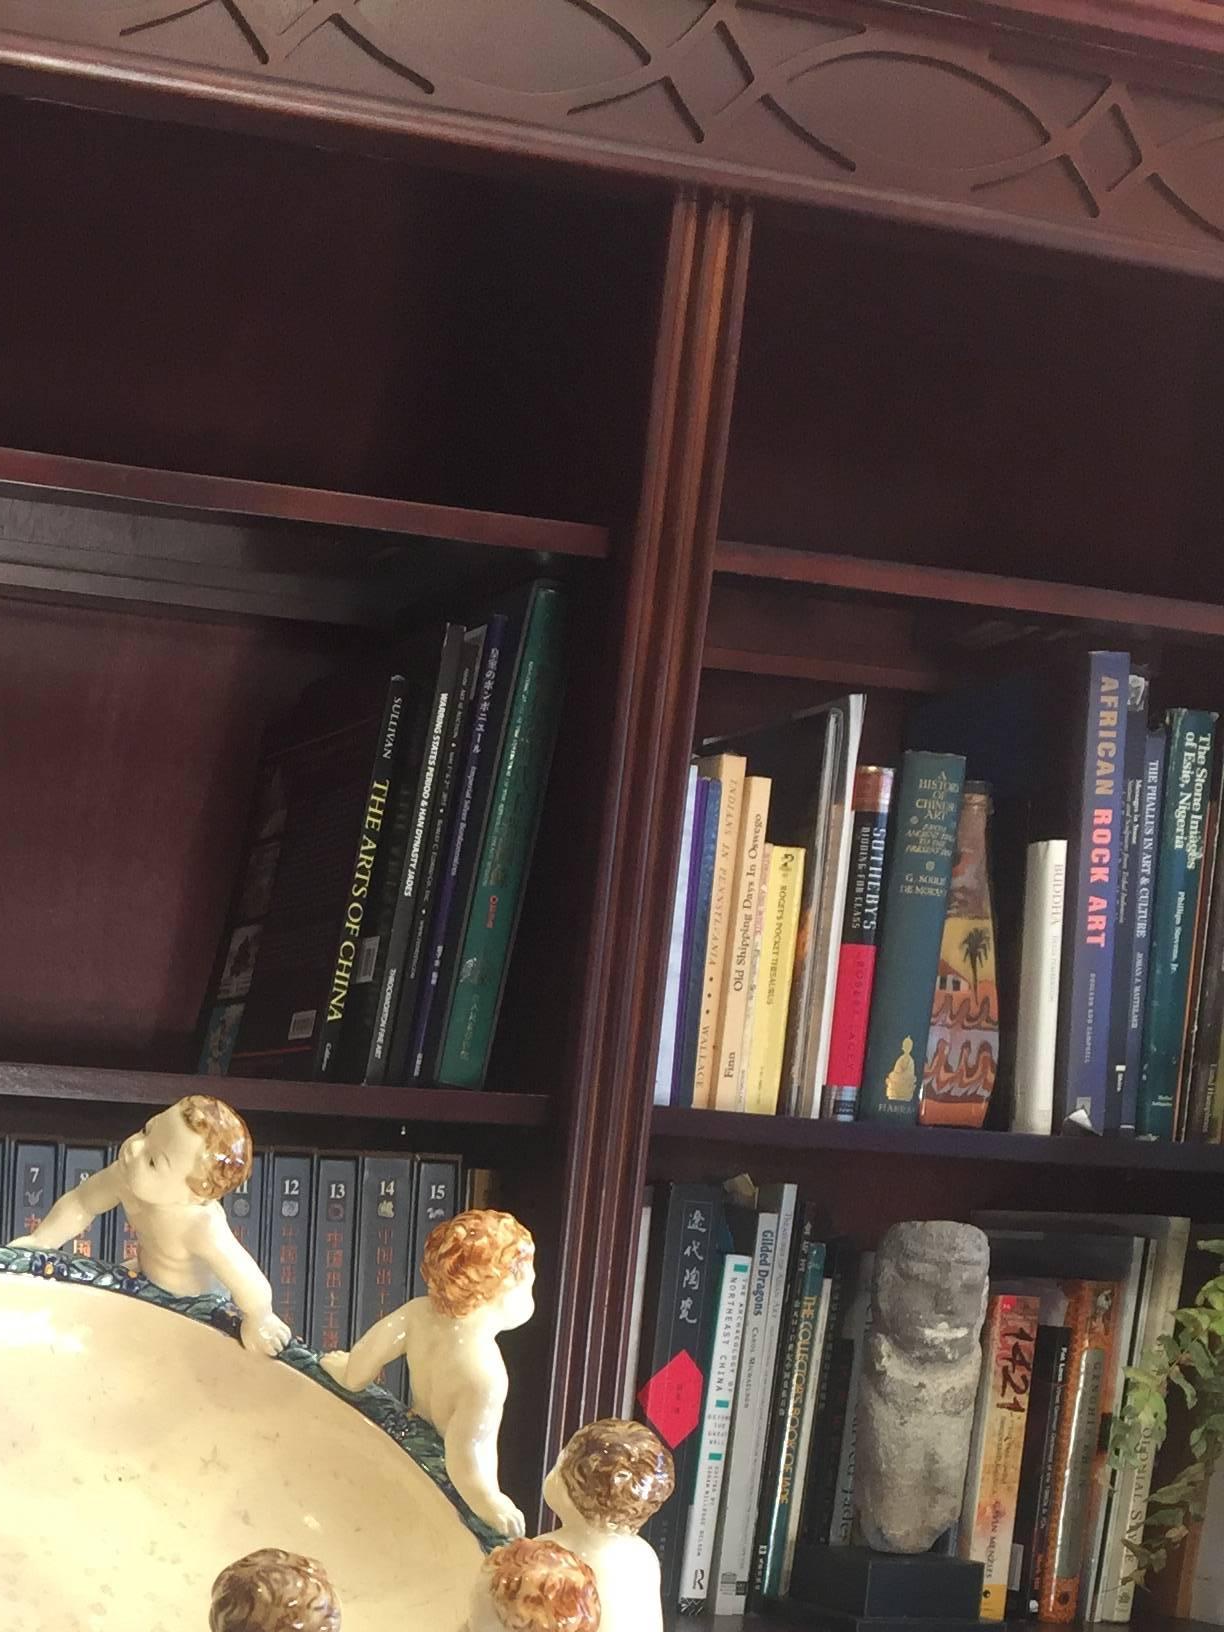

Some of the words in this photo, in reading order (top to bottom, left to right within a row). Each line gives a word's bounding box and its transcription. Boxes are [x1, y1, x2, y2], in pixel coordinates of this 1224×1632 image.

[382, 696, 403, 760] SULLIVAN
[433, 692, 449, 735] WARRING
[427, 735, 441, 766] STATES
[1095, 675, 1119, 795] AFRICAN
[1184, 731, 1197, 748] of
[1197, 732, 1212, 765] The
[422, 766, 435, 799] PERIOD
[937, 771, 947, 780] A
[1147, 760, 1160, 783] THE
[364, 778, 391, 832] THE
[421, 799, 429, 808] &
[1192, 767, 1208, 812] Stone
[416, 807, 427, 829] HAN
[924, 810, 946, 820] ART
[1144, 784, 1157, 836] PHALLUS
[1174, 791, 1192, 849] Nigeria
[409, 828, 423, 870] DYNASTY
[748, 812, 763, 860] Oswego
[856, 826, 870, 871] BIDDING
[1089, 808, 1113, 884] ROCK
[1143, 837, 1154, 850] IN
[1186, 814, 1204, 870] Images
[351, 834, 378, 898] ARTS
[747, 867, 757, 878] In
[1139, 875, 1151, 885] &
[1140, 852, 1153, 875] ART
[404, 869, 416, 897] JADES
[743, 880, 758, 910] Days
[855, 873, 866, 893] FOR
[1051, 863, 1065, 925] BUDDHA
[345, 902, 364, 938] OF
[851, 896, 864, 930] CLASS
[1086, 895, 1108, 948] ART
[1136, 888, 1150, 938] CULTURE
[1174, 891, 1186, 925] Phillips
[736, 910, 754, 970] Shipping
[326, 940, 356, 1023] CHINA
[733, 973, 745, 992] Old
[695, 1025, 711, 1087] WALLACE
[723, 1051, 736, 1078] Finn
[29, 1167, 40, 1184] 7
[283, 1179, 300, 1196] 12
[329, 1183, 346, 1199] 13
[379, 1180, 395, 1197] 14
[430, 1184, 445, 1200] 15
[758, 1229, 775, 1267] Gilded
[751, 1269, 769, 1317] Dragons
[802, 1295, 818, 1320] THE
[722, 1277, 738, 1346] NORTHEAST
[730, 1302, 744, 1373] ARCHAEOLOGY
[715, 1354, 727, 1392] CHINA
[727, 1380, 734, 1393] OF
[996, 1328, 1035, 1412] 1421
[785, 1407, 801, 1450] BOOK
[782, 1453, 795, 1475] OF
[777, 1476, 792, 1505] JADE
[985, 1536, 998, 1579] MENZIES
